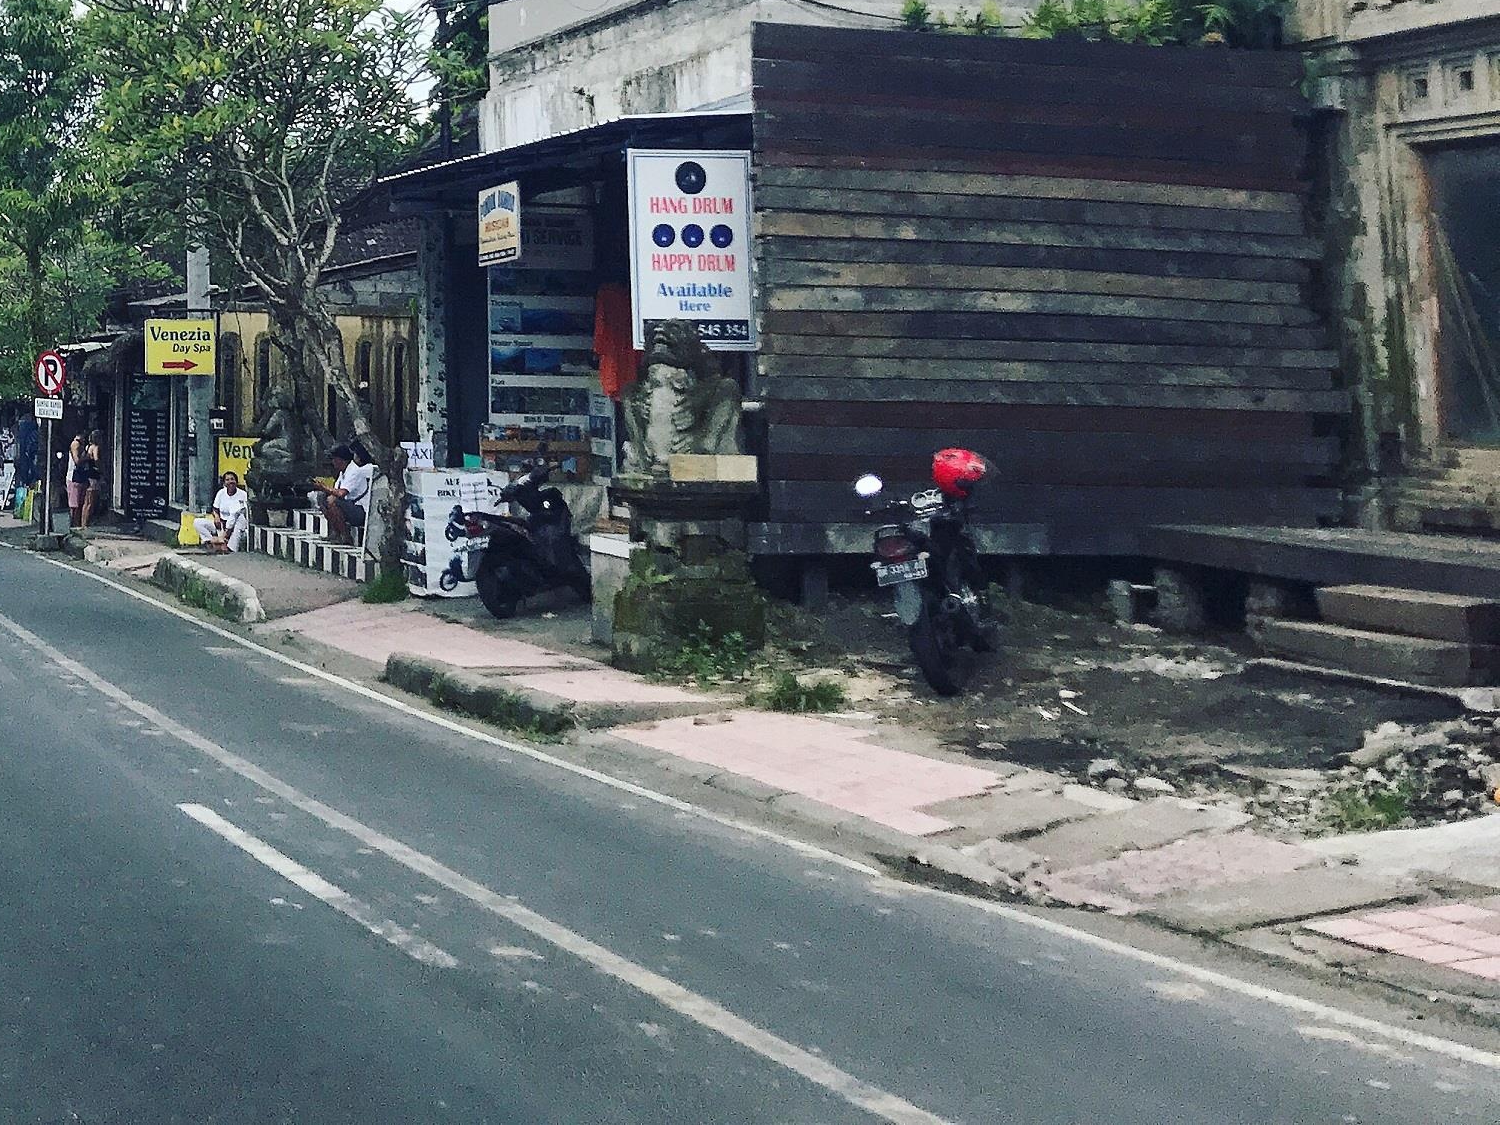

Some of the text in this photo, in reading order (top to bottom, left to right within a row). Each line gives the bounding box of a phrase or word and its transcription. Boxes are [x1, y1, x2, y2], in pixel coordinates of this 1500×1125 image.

[650, 197, 734, 215] HANG DRUM
[651, 254, 736, 272] HAPPY DRUM
[657, 283, 734, 298] Available
[679, 300, 712, 312] Here
[150, 326, 212, 342] Venezia
[173, 343, 212, 355] Day Spa
[405, 448, 432, 460] TAXI
